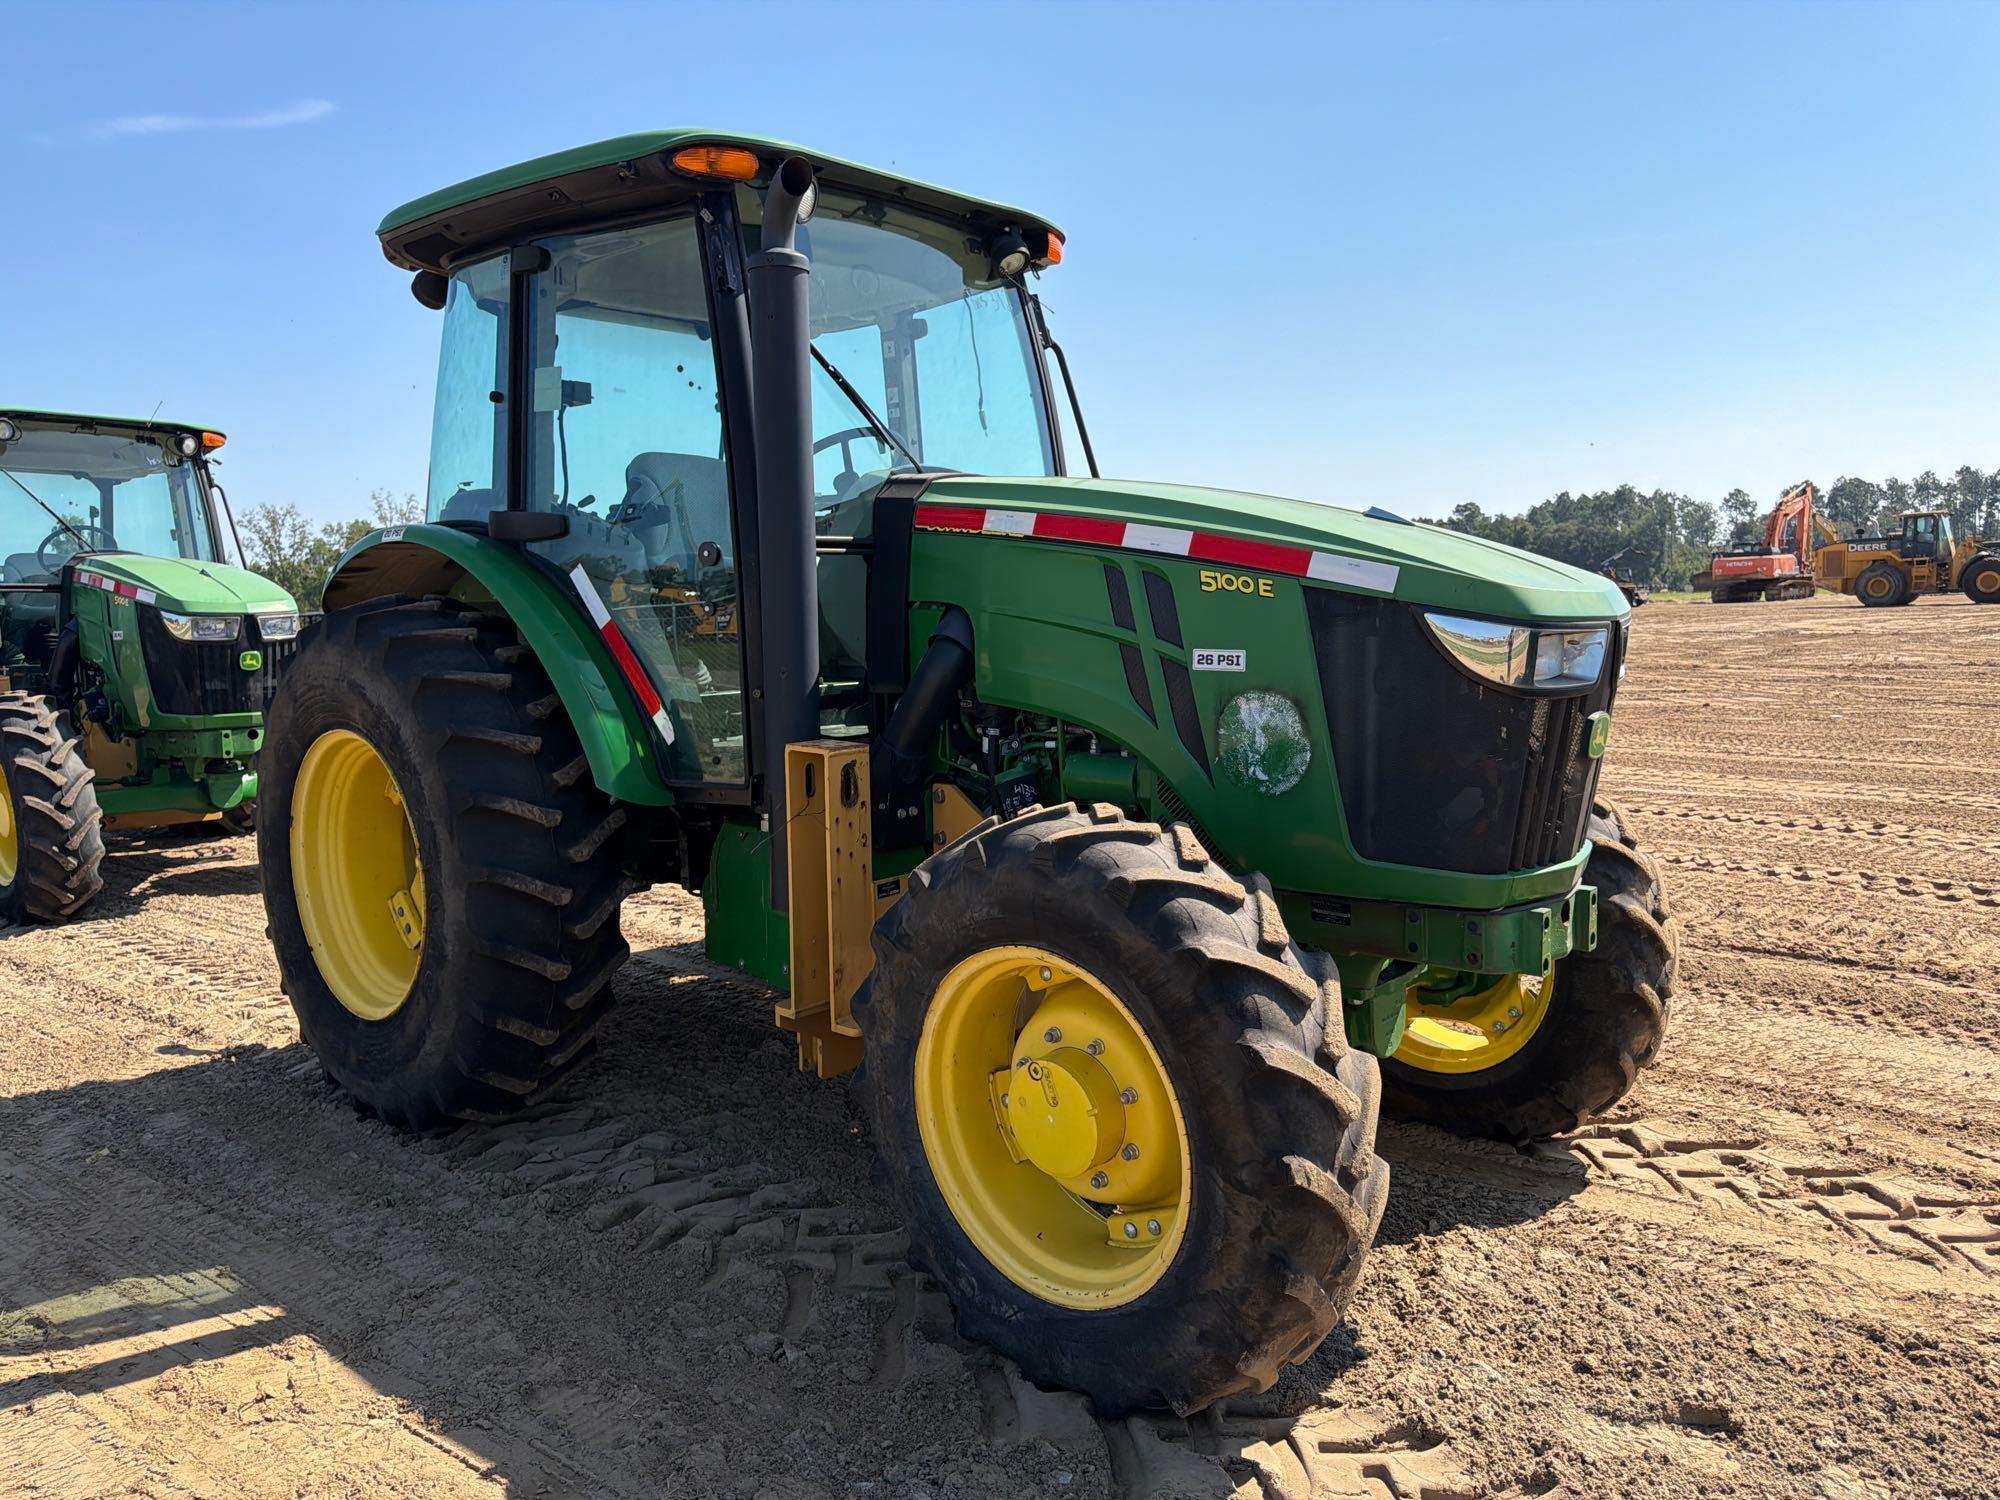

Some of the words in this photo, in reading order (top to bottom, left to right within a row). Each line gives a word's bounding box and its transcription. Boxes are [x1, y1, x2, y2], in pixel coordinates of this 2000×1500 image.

[1848, 543, 1887, 552] DEERE
[1200, 570, 1255, 594] 5100
[1197, 654, 1214, 665] 26
[1217, 654, 1242, 666] PSI
